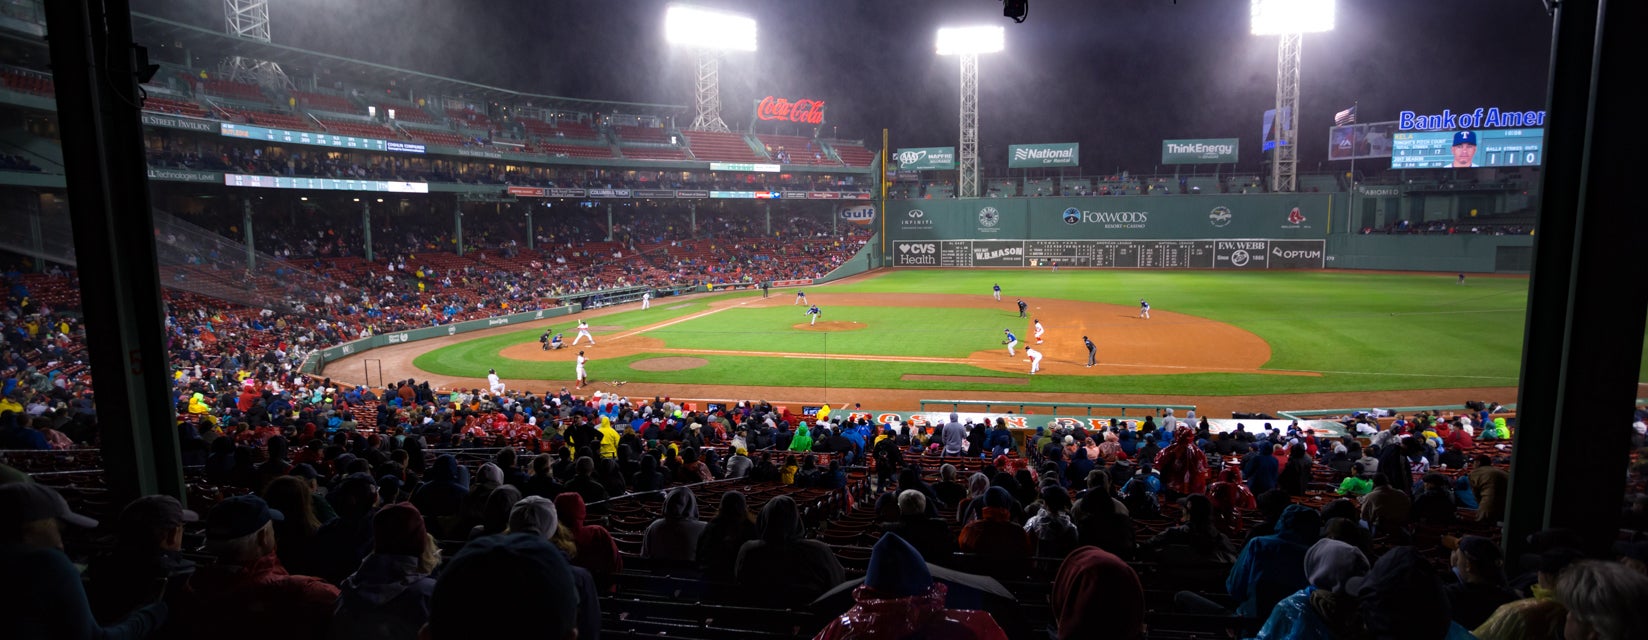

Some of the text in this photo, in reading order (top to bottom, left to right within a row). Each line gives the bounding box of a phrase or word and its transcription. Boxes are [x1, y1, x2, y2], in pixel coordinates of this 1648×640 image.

[757, 96, 825, 124] Coca-Cola
[150, 116, 175, 127] STREET
[178, 119, 210, 131] PAVILION
[1399, 107, 1546, 130] Bank of Amer
[1027, 148, 1073, 159] National
[1167, 143, 1232, 155] ThinkEnergy
[1491, 152, 1535, 165] 1 1 0
[156, 170, 197, 181] Technologies
[199, 173, 215, 181] Level
[841, 208, 873, 218] Gulf
[1083, 210, 1148, 223] FOXWOODS
[910, 243, 936, 254] CVS
[1218, 242, 1265, 250] F.W. WEBB
[900, 254, 935, 265] Health
[1283, 250, 1321, 259] OPTUM
